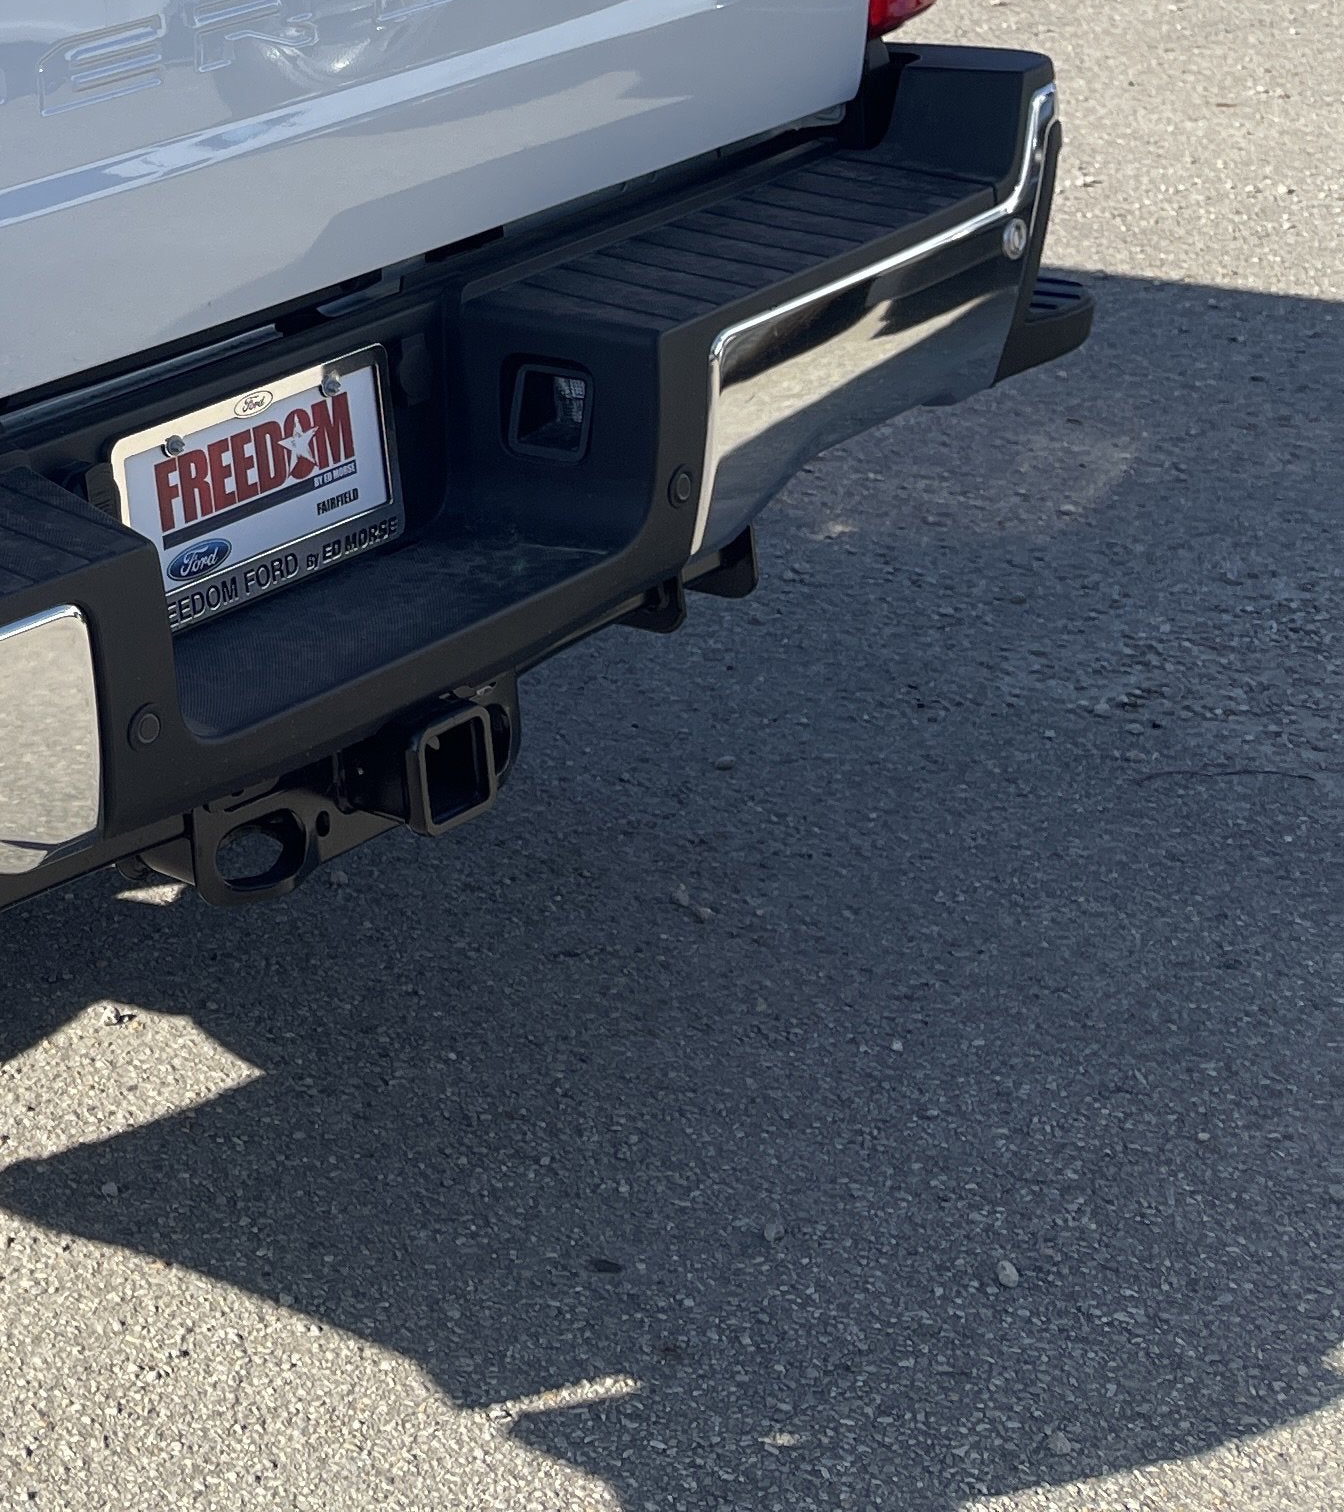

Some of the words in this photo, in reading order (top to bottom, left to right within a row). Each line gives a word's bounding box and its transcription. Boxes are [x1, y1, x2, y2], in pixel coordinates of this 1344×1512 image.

[242, 394, 266, 413] Ford
[154, 391, 356, 533] FREEDOM
[313, 475, 323, 488] BY
[323, 471, 333, 484] ED
[332, 461, 356, 480] MORSE
[316, 487, 359, 516] FAIRFIELD
[167, 576, 239, 628] EEDOM
[243, 552, 299, 596] FORD
[322, 539, 342, 564] ED
[343, 516, 399, 555] MORSE
[180, 545, 218, 577] Ford
